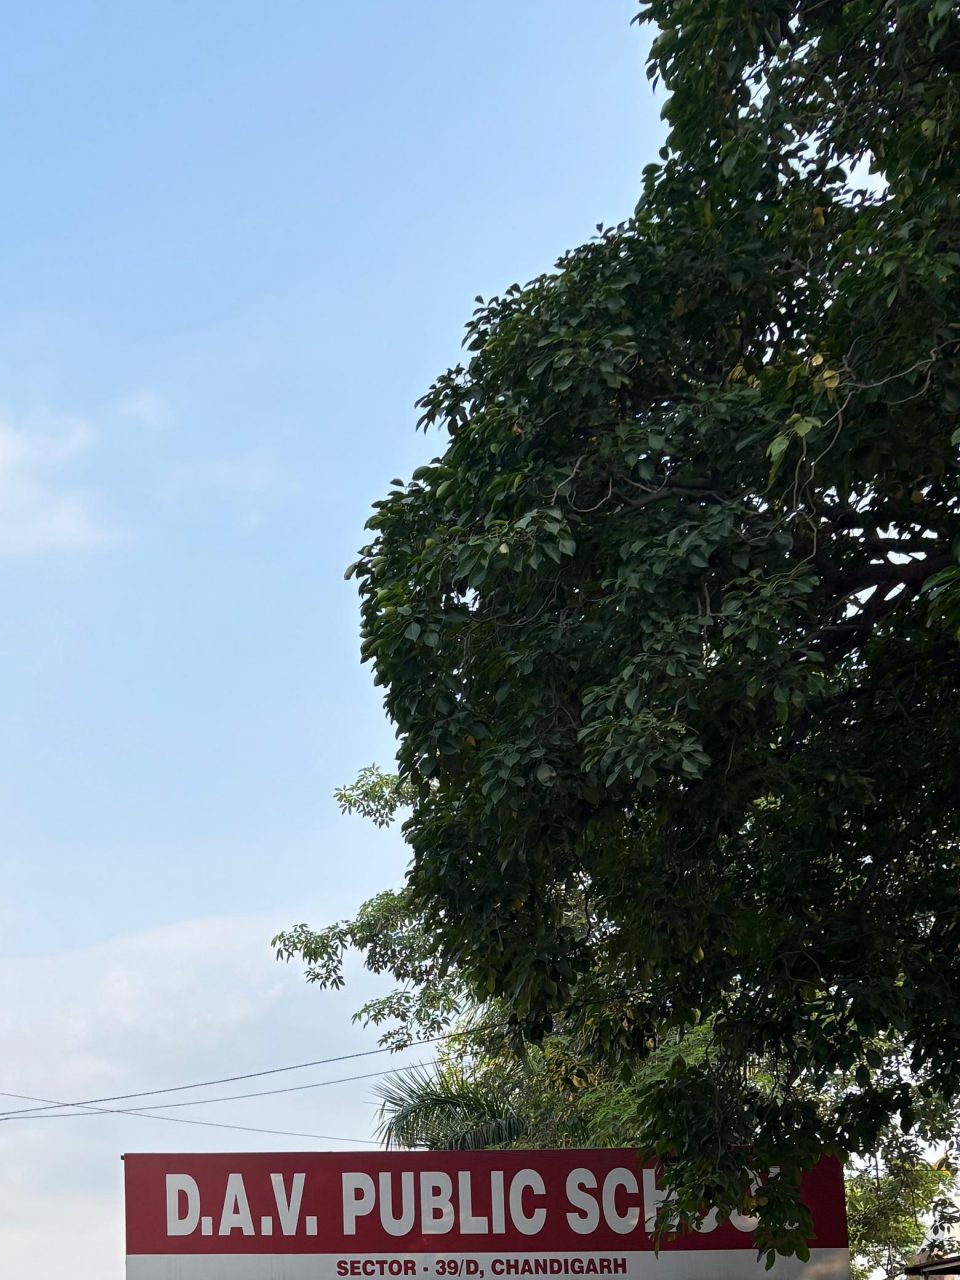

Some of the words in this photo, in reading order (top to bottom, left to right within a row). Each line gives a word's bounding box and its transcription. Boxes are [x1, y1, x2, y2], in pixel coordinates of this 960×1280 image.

[165, 1172, 318, 1236] D.A.V.
[341, 1168, 547, 1237] PUBLIC
[336, 1259, 417, 1276] SECTOR
[435, 1258, 484, 1278] 39/D,
[490, 1257, 628, 1277] CHANDIGARH
